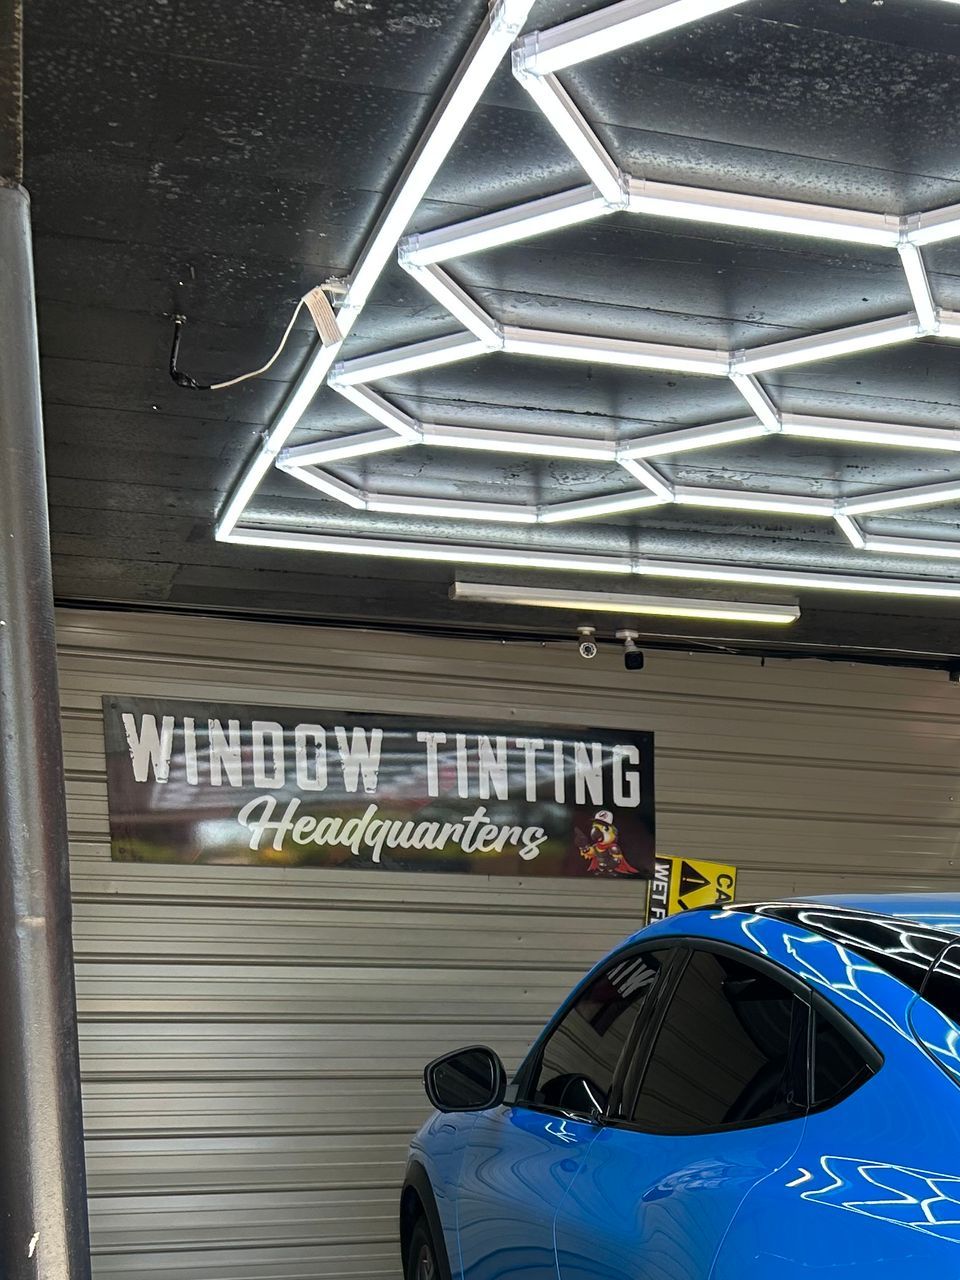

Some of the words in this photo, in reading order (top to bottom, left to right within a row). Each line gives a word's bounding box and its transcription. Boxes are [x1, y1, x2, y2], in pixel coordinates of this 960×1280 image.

[121, 711, 384, 794] WINDOW
[417, 731, 641, 808] TINTING
[237, 794, 548, 863] Headquarters
[652, 864, 670, 904] WET
